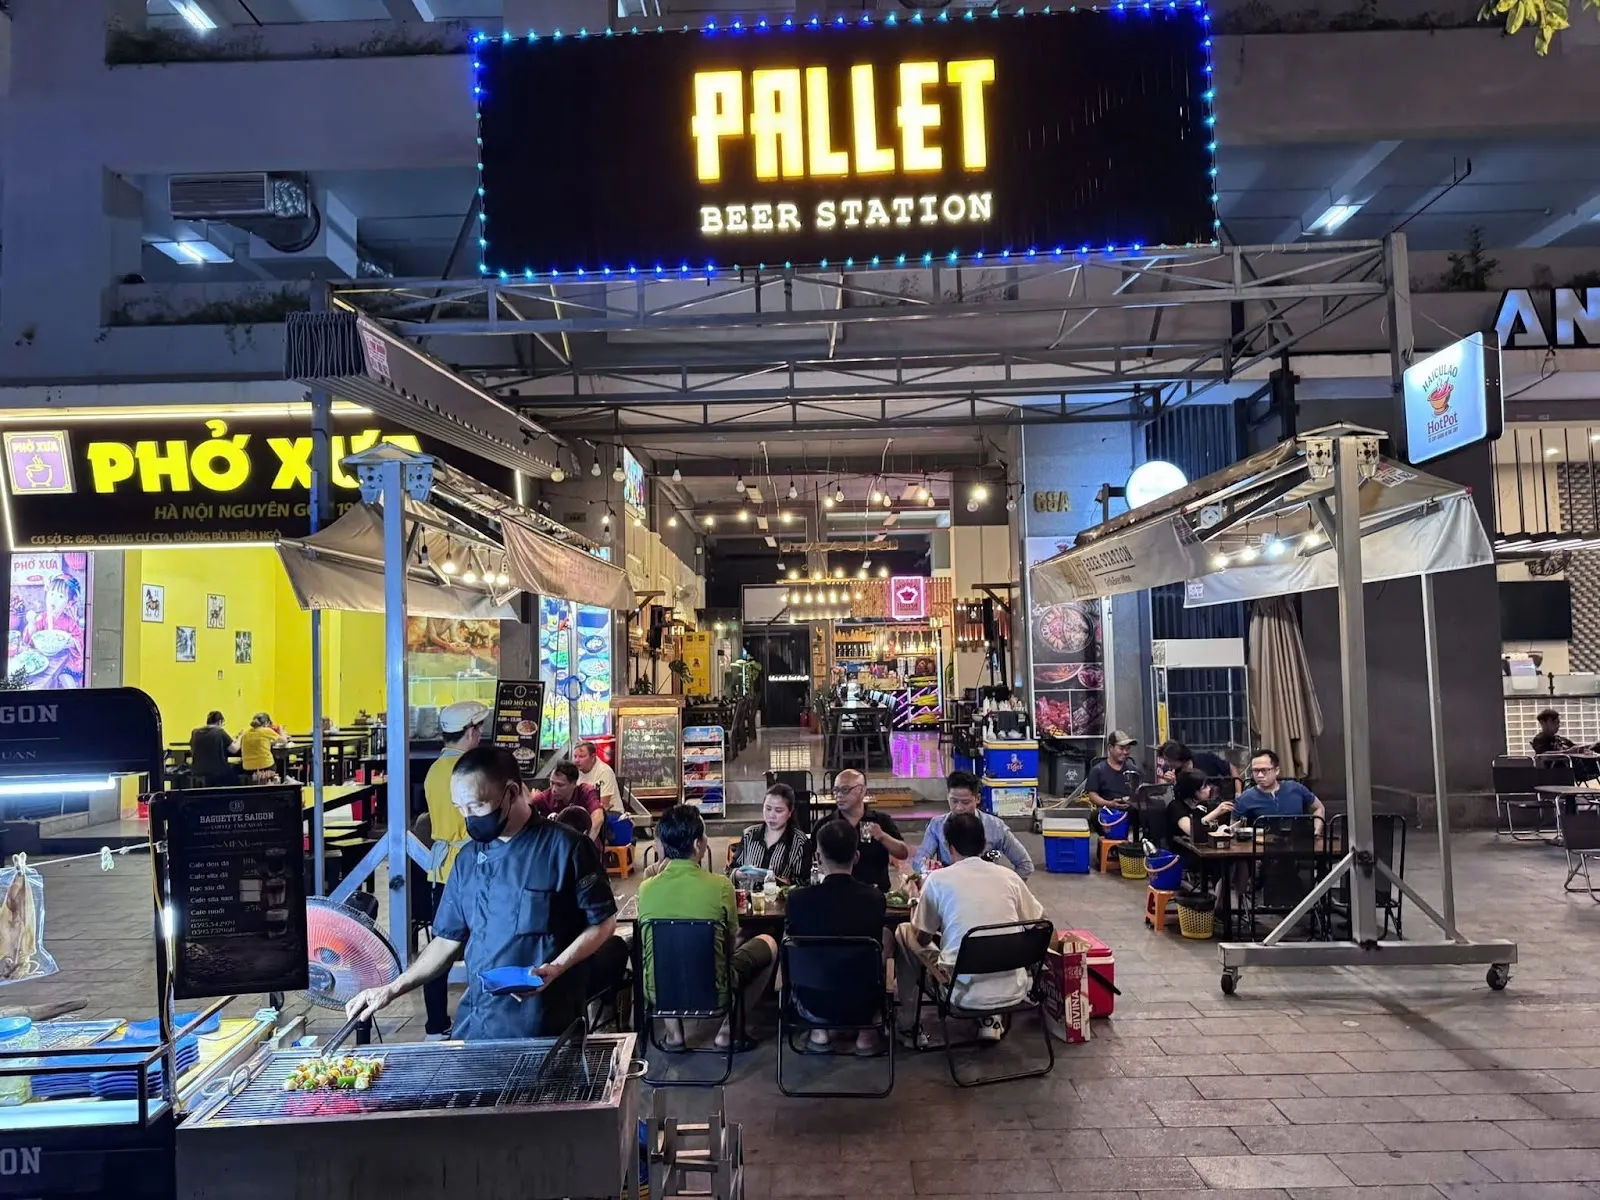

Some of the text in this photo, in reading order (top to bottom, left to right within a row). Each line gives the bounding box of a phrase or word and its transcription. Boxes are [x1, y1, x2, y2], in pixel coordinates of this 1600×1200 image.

[692, 59, 996, 182] PALLET
[700, 192, 993, 233] BEER STATION
[1427, 412, 1458, 434] HotPot
[87, 419, 251, 493] PHỞ
[154, 503, 179, 519] HÀ
[181, 502, 213, 522] NỘI
[218, 501, 290, 518] NGUYÊN
[1099, 545, 1134, 568] STATION
[0, 704, 59, 724] GON
[199, 811, 275, 824] BAGUETTE SAIGON
[0, 1146, 42, 1176] ON
